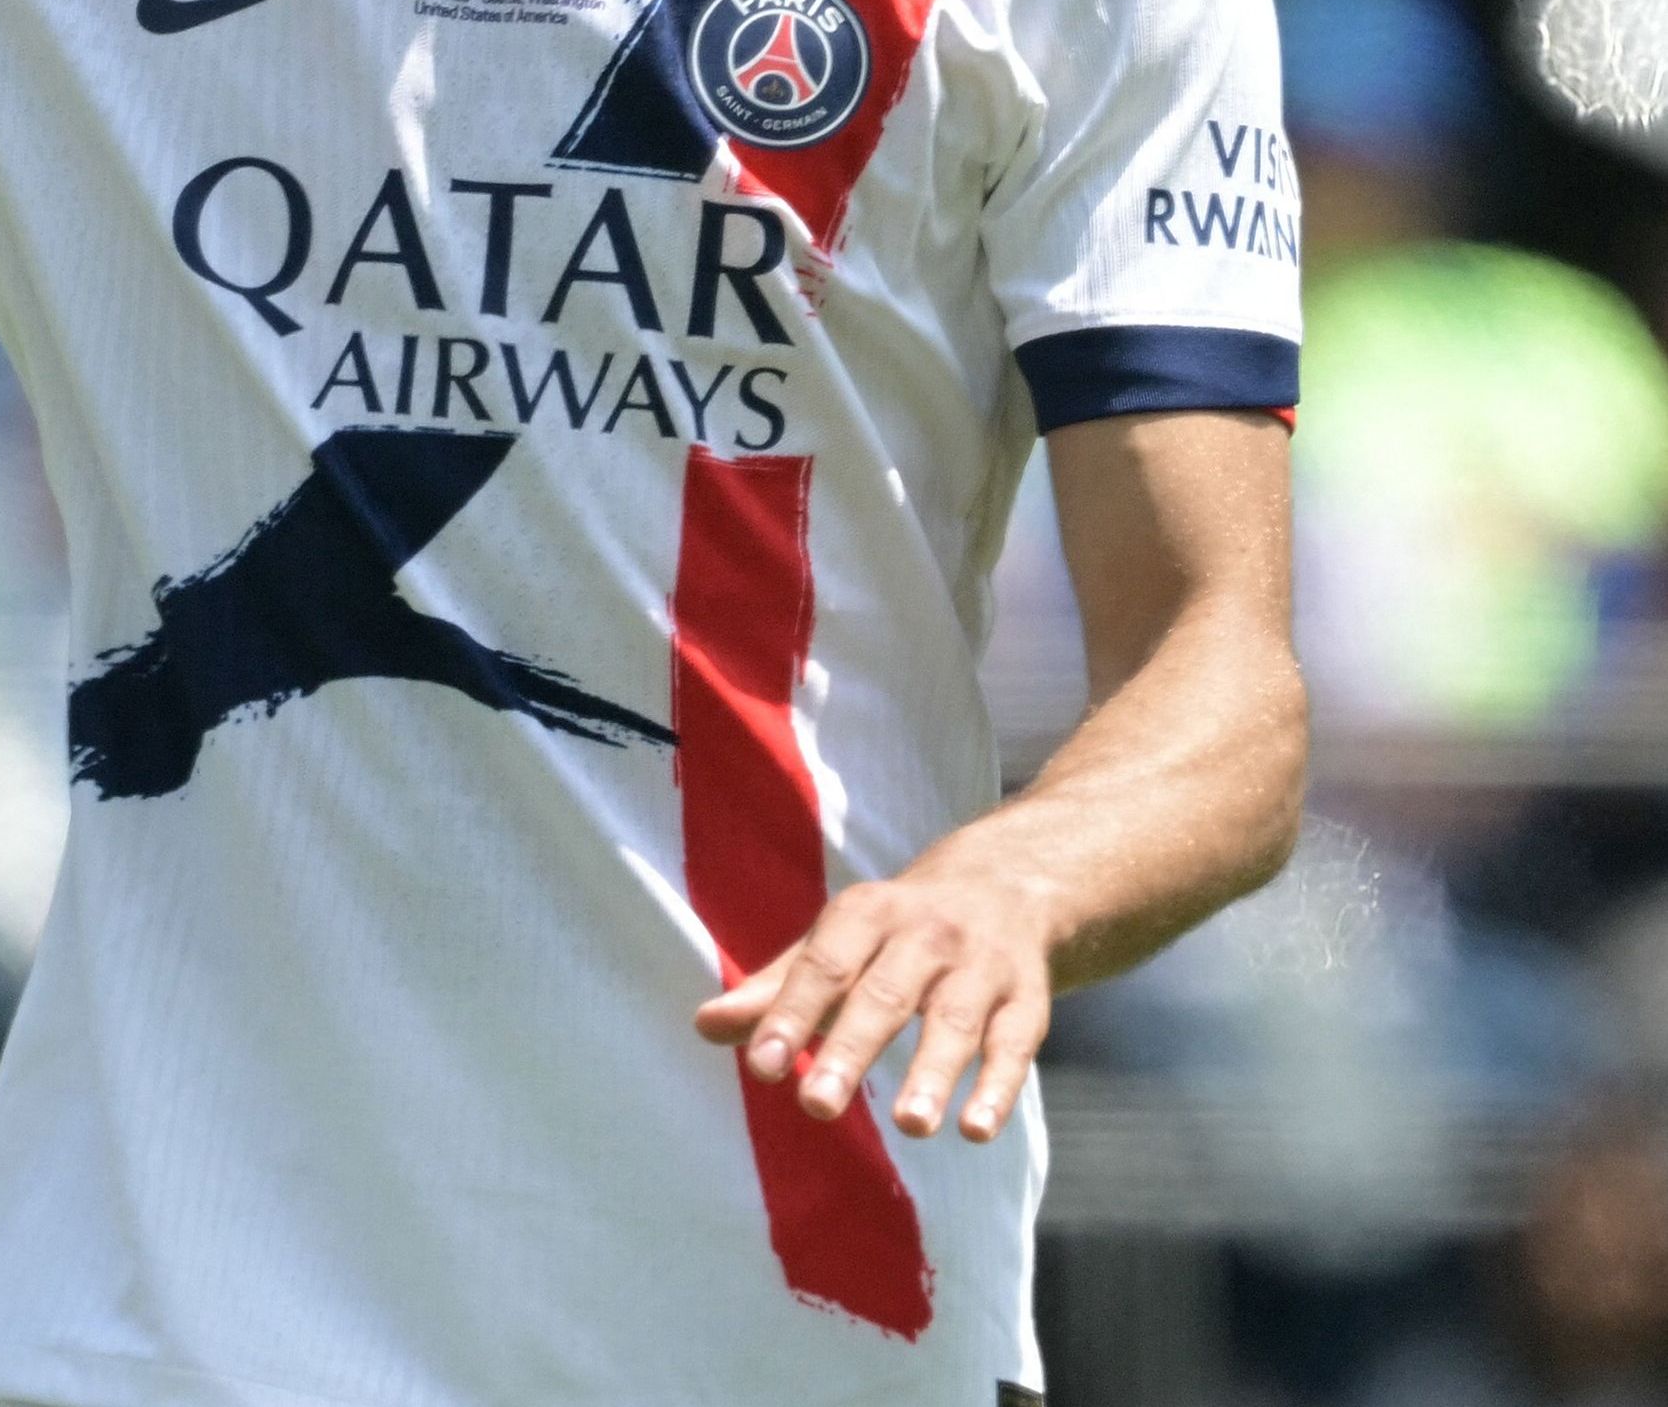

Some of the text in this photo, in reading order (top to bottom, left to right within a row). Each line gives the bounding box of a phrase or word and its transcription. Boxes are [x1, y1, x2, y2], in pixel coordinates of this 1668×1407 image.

[414, 0, 459, 20] United
[460, 6, 501, 23] States
[516, 8, 568, 25] America
[717, 85, 752, 122] SAINT
[762, 106, 828, 132] GERMAIN
[172, 156, 795, 347] QATAR
[310, 331, 788, 452] AIRWAYS
